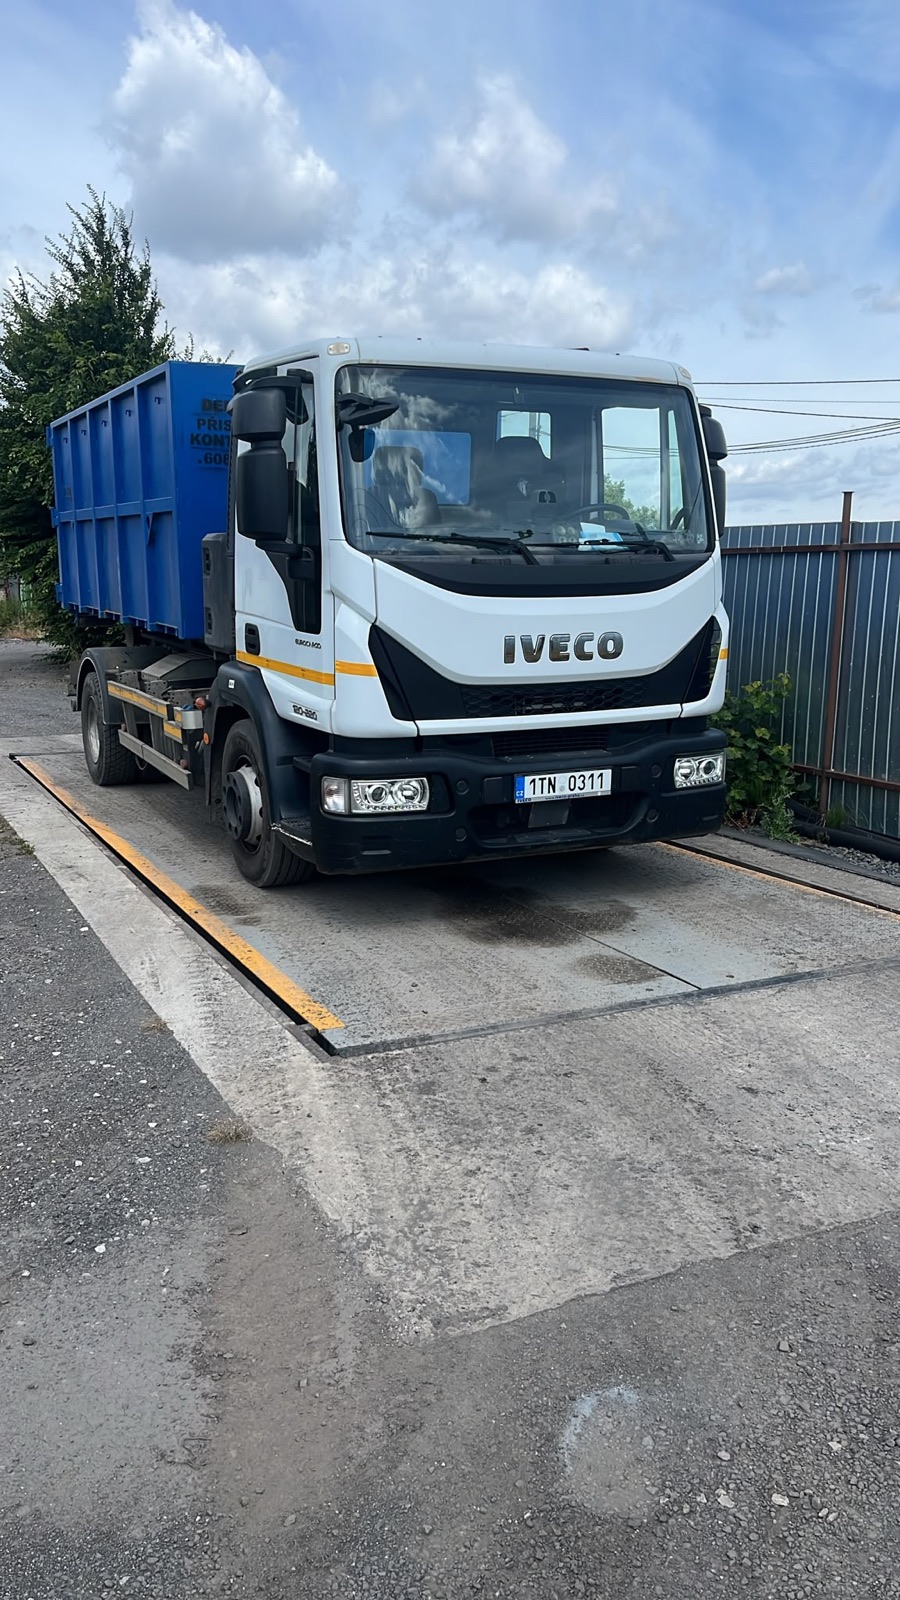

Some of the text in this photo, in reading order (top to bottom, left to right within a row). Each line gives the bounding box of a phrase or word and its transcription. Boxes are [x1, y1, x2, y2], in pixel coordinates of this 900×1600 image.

[503, 631, 624, 664] IVECO
[529, 772, 604, 796] 1TN 0311
